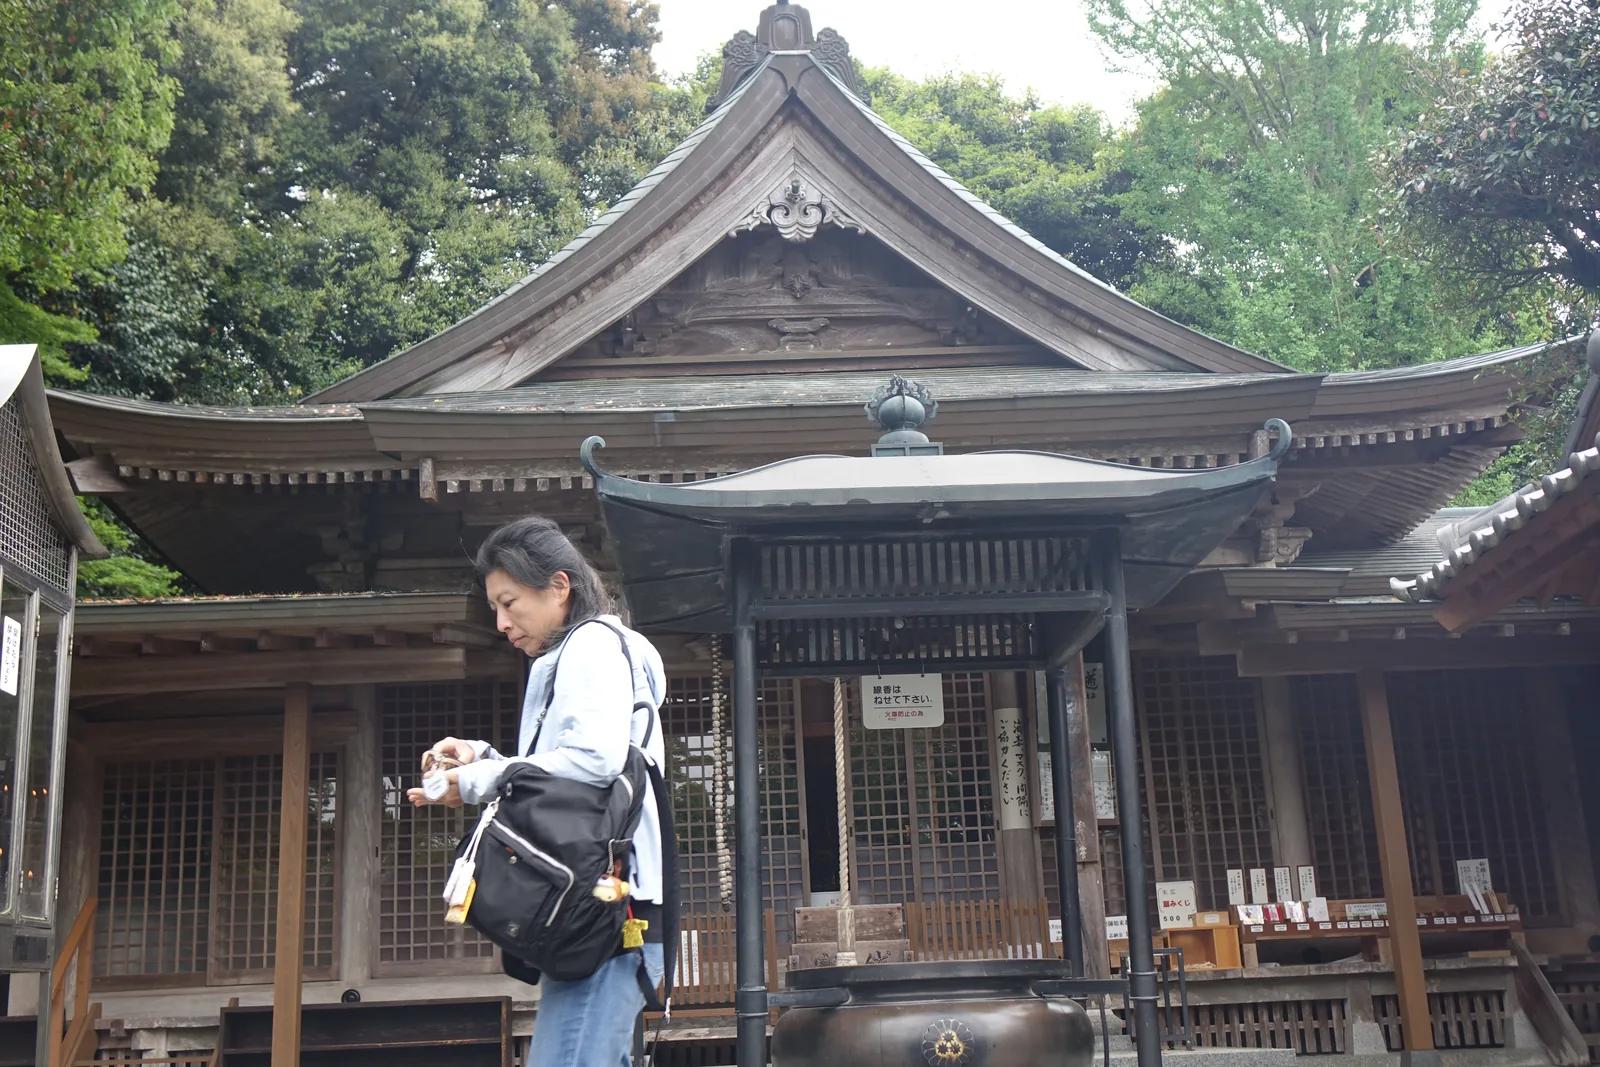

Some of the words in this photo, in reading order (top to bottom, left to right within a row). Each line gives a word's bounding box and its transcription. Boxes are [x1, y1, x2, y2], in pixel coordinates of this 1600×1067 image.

[873, 685, 901, 694] 線香は
[884, 710, 924, 718] 火傷防止の為
[997, 719, 1013, 805] ご協力ください
